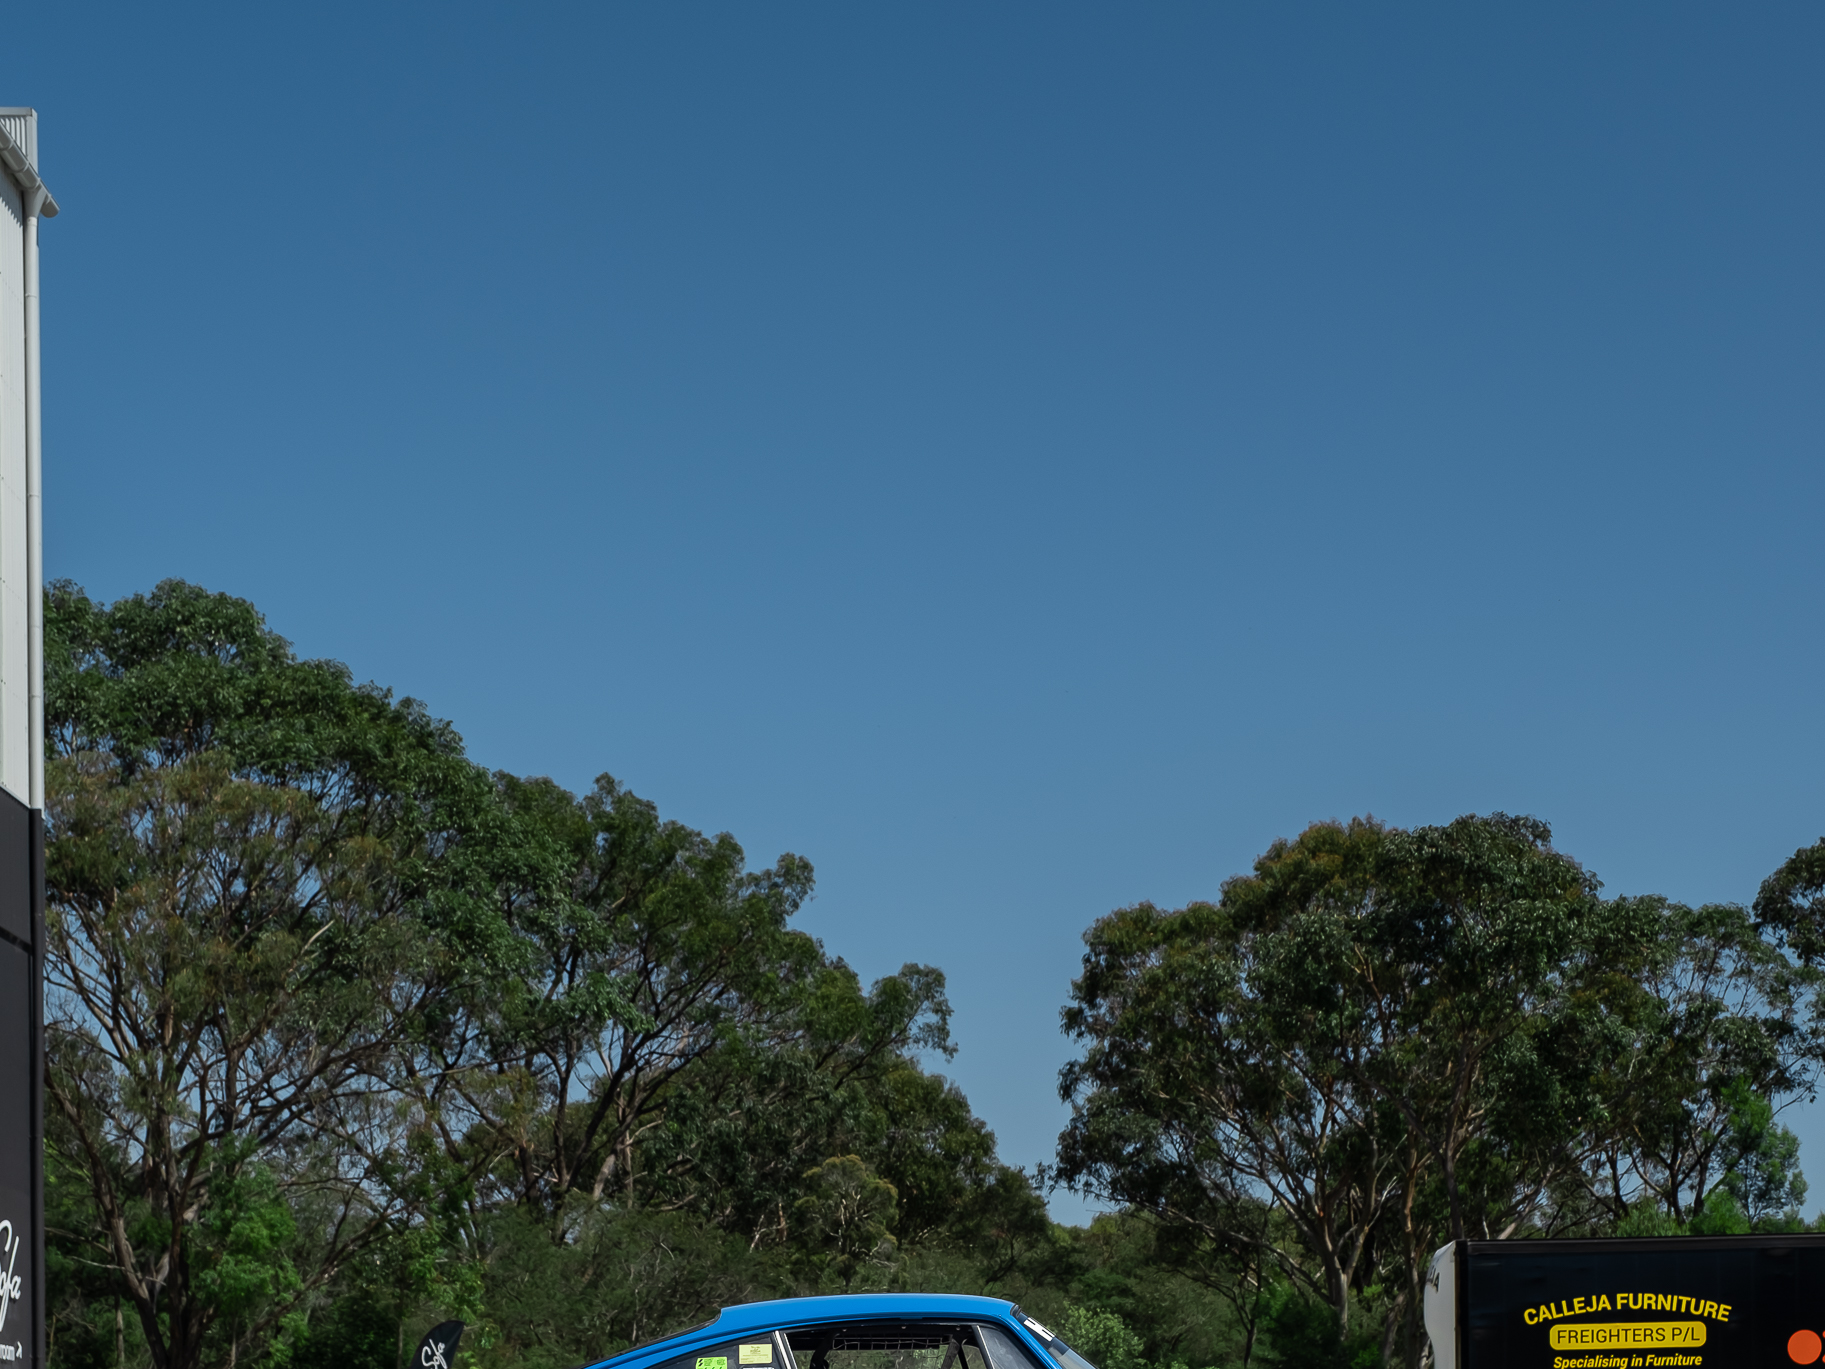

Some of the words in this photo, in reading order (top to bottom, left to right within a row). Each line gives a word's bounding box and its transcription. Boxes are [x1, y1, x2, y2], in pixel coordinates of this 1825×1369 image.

[1523, 1294, 1612, 1325] CALLEJA
[1616, 1293, 1732, 1322] FURNITURE
[1556, 1327, 1666, 1345] FREIGHTERS
[1671, 1326, 1701, 1342] P/L
[1631, 1354, 1643, 1367] in
[1645, 1353, 1703, 1367] Furniture
